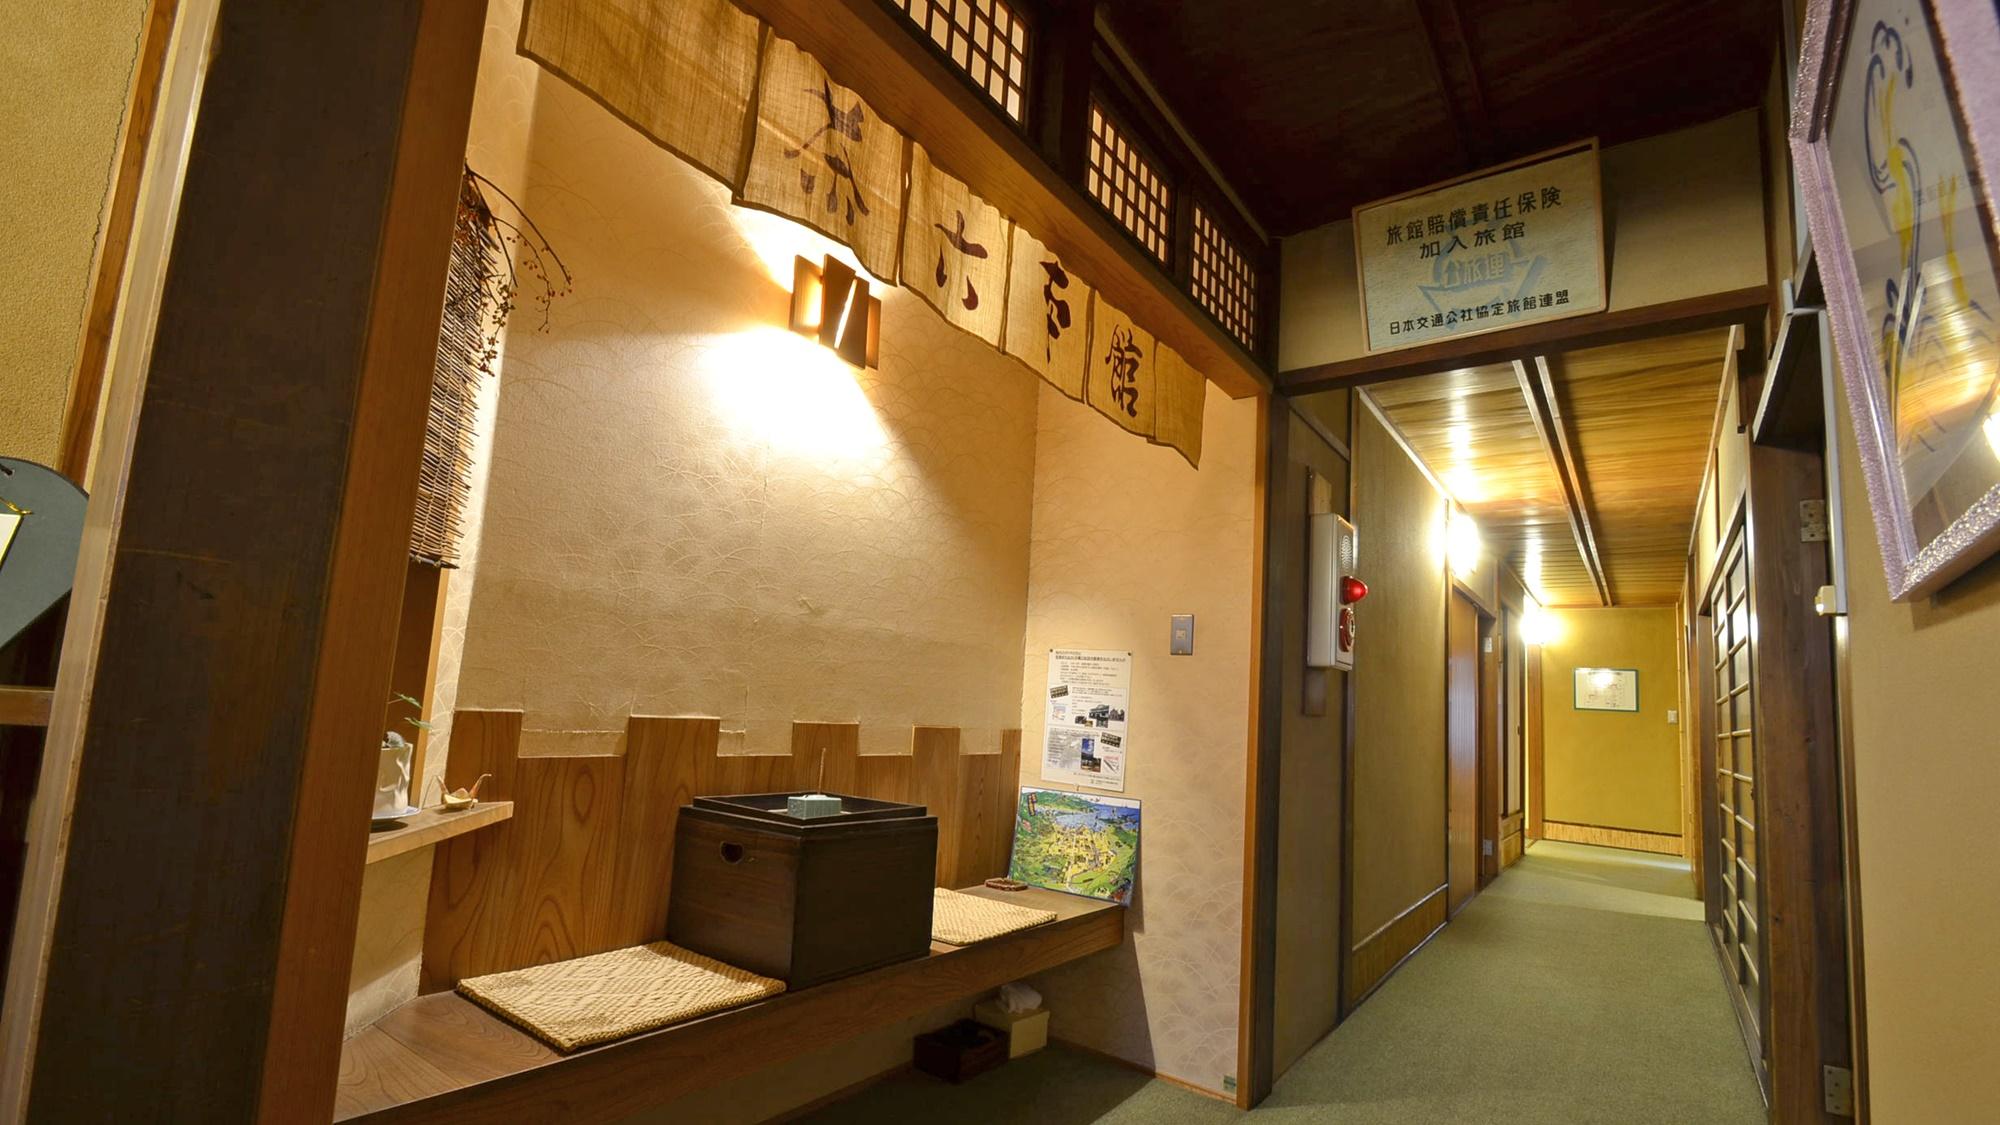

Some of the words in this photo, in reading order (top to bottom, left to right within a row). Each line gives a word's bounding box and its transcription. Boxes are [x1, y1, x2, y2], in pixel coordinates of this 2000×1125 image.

[1386, 186, 1562, 246] 旅館賠償責任保険
[1419, 222, 1526, 260] 加入旅館
[1389, 289, 1570, 335] 日本交通公社協定旅館連盟
